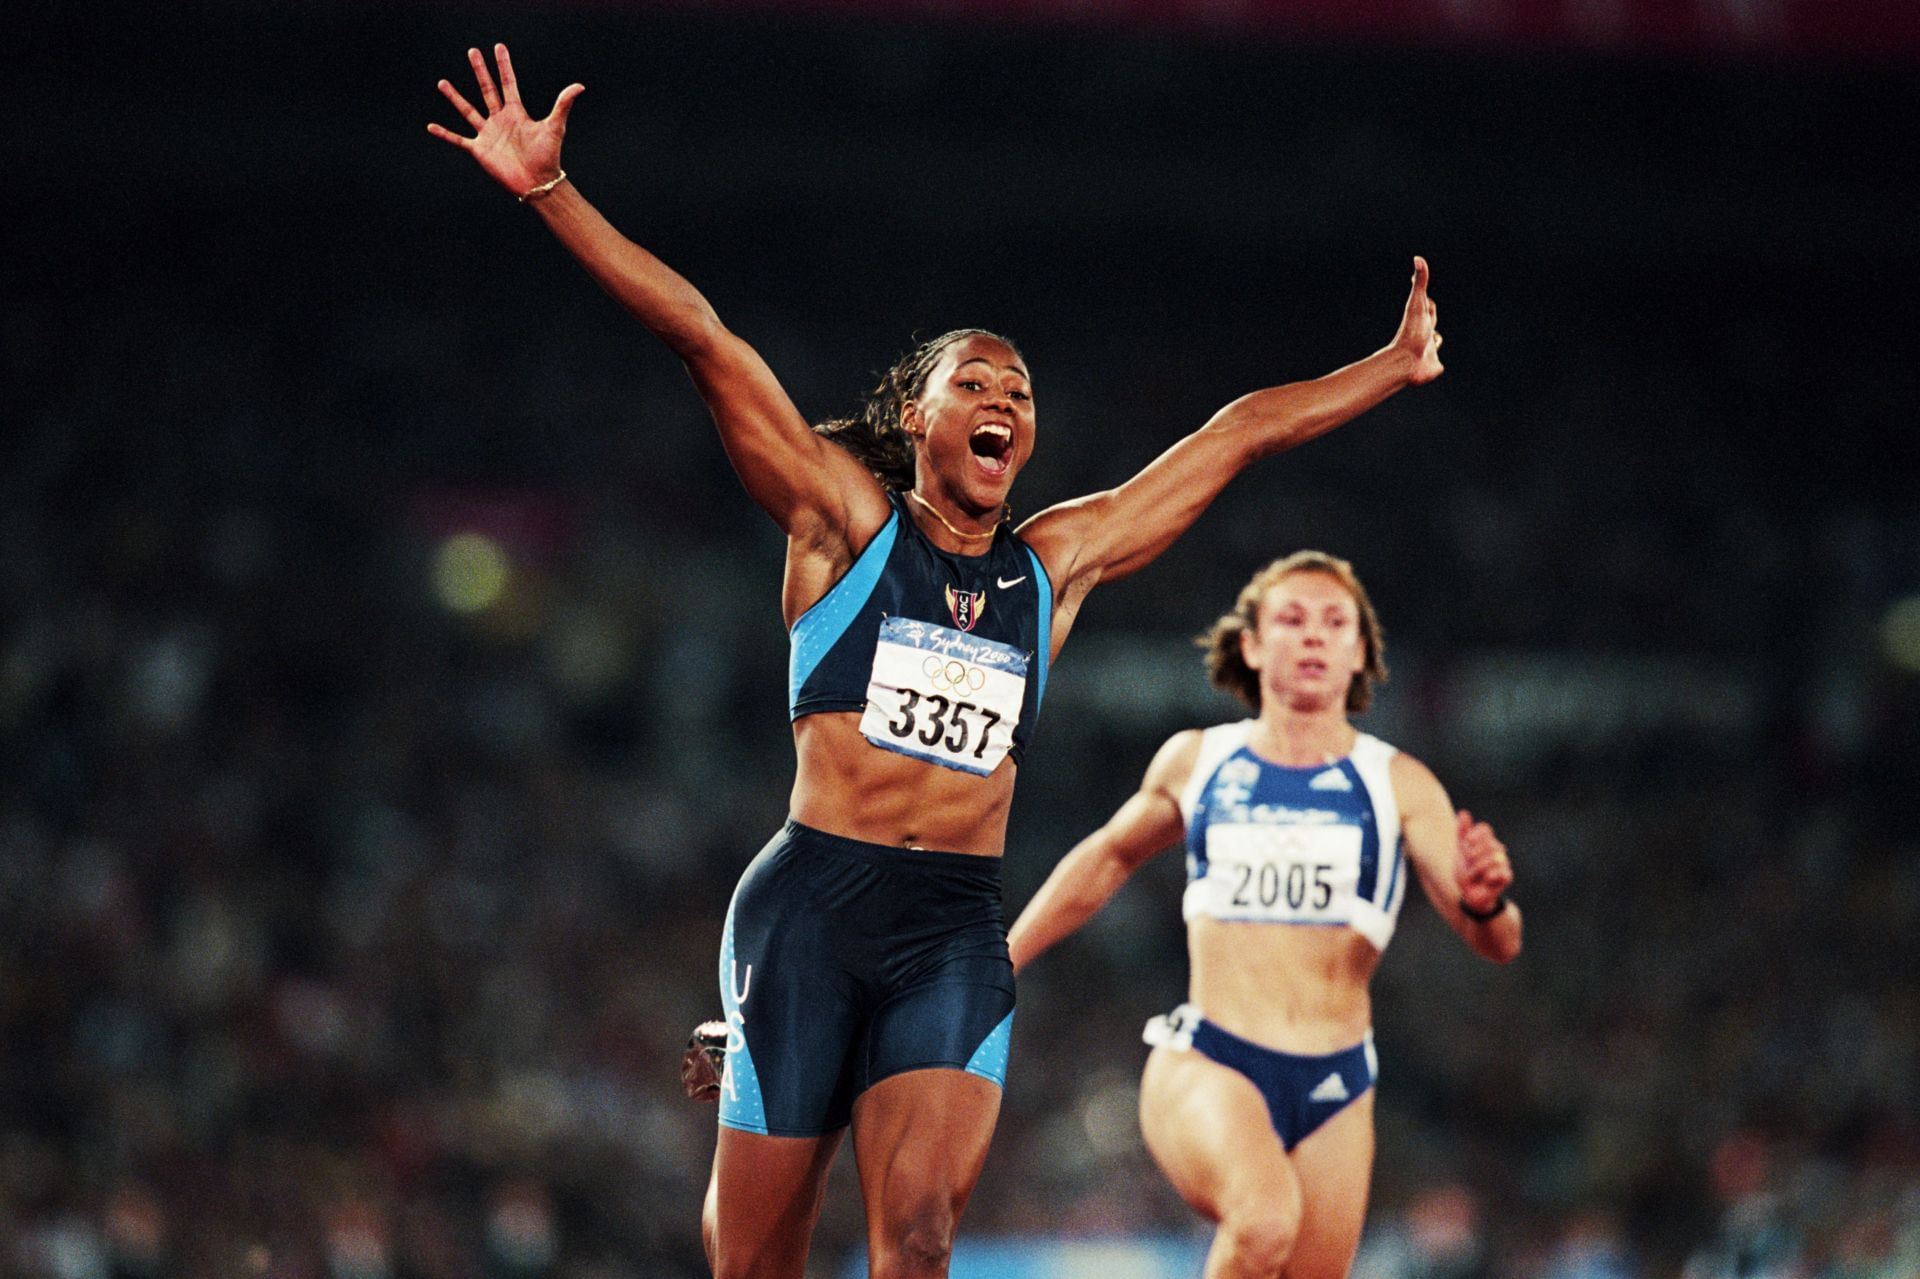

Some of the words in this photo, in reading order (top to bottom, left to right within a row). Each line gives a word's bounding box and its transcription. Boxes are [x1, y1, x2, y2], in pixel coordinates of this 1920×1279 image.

[959, 595, 969, 623] USA
[929, 627, 978, 663] Sydney
[889, 688, 1001, 759] 3357
[1232, 863, 1332, 910] 2005
[721, 960, 752, 1102] USA
